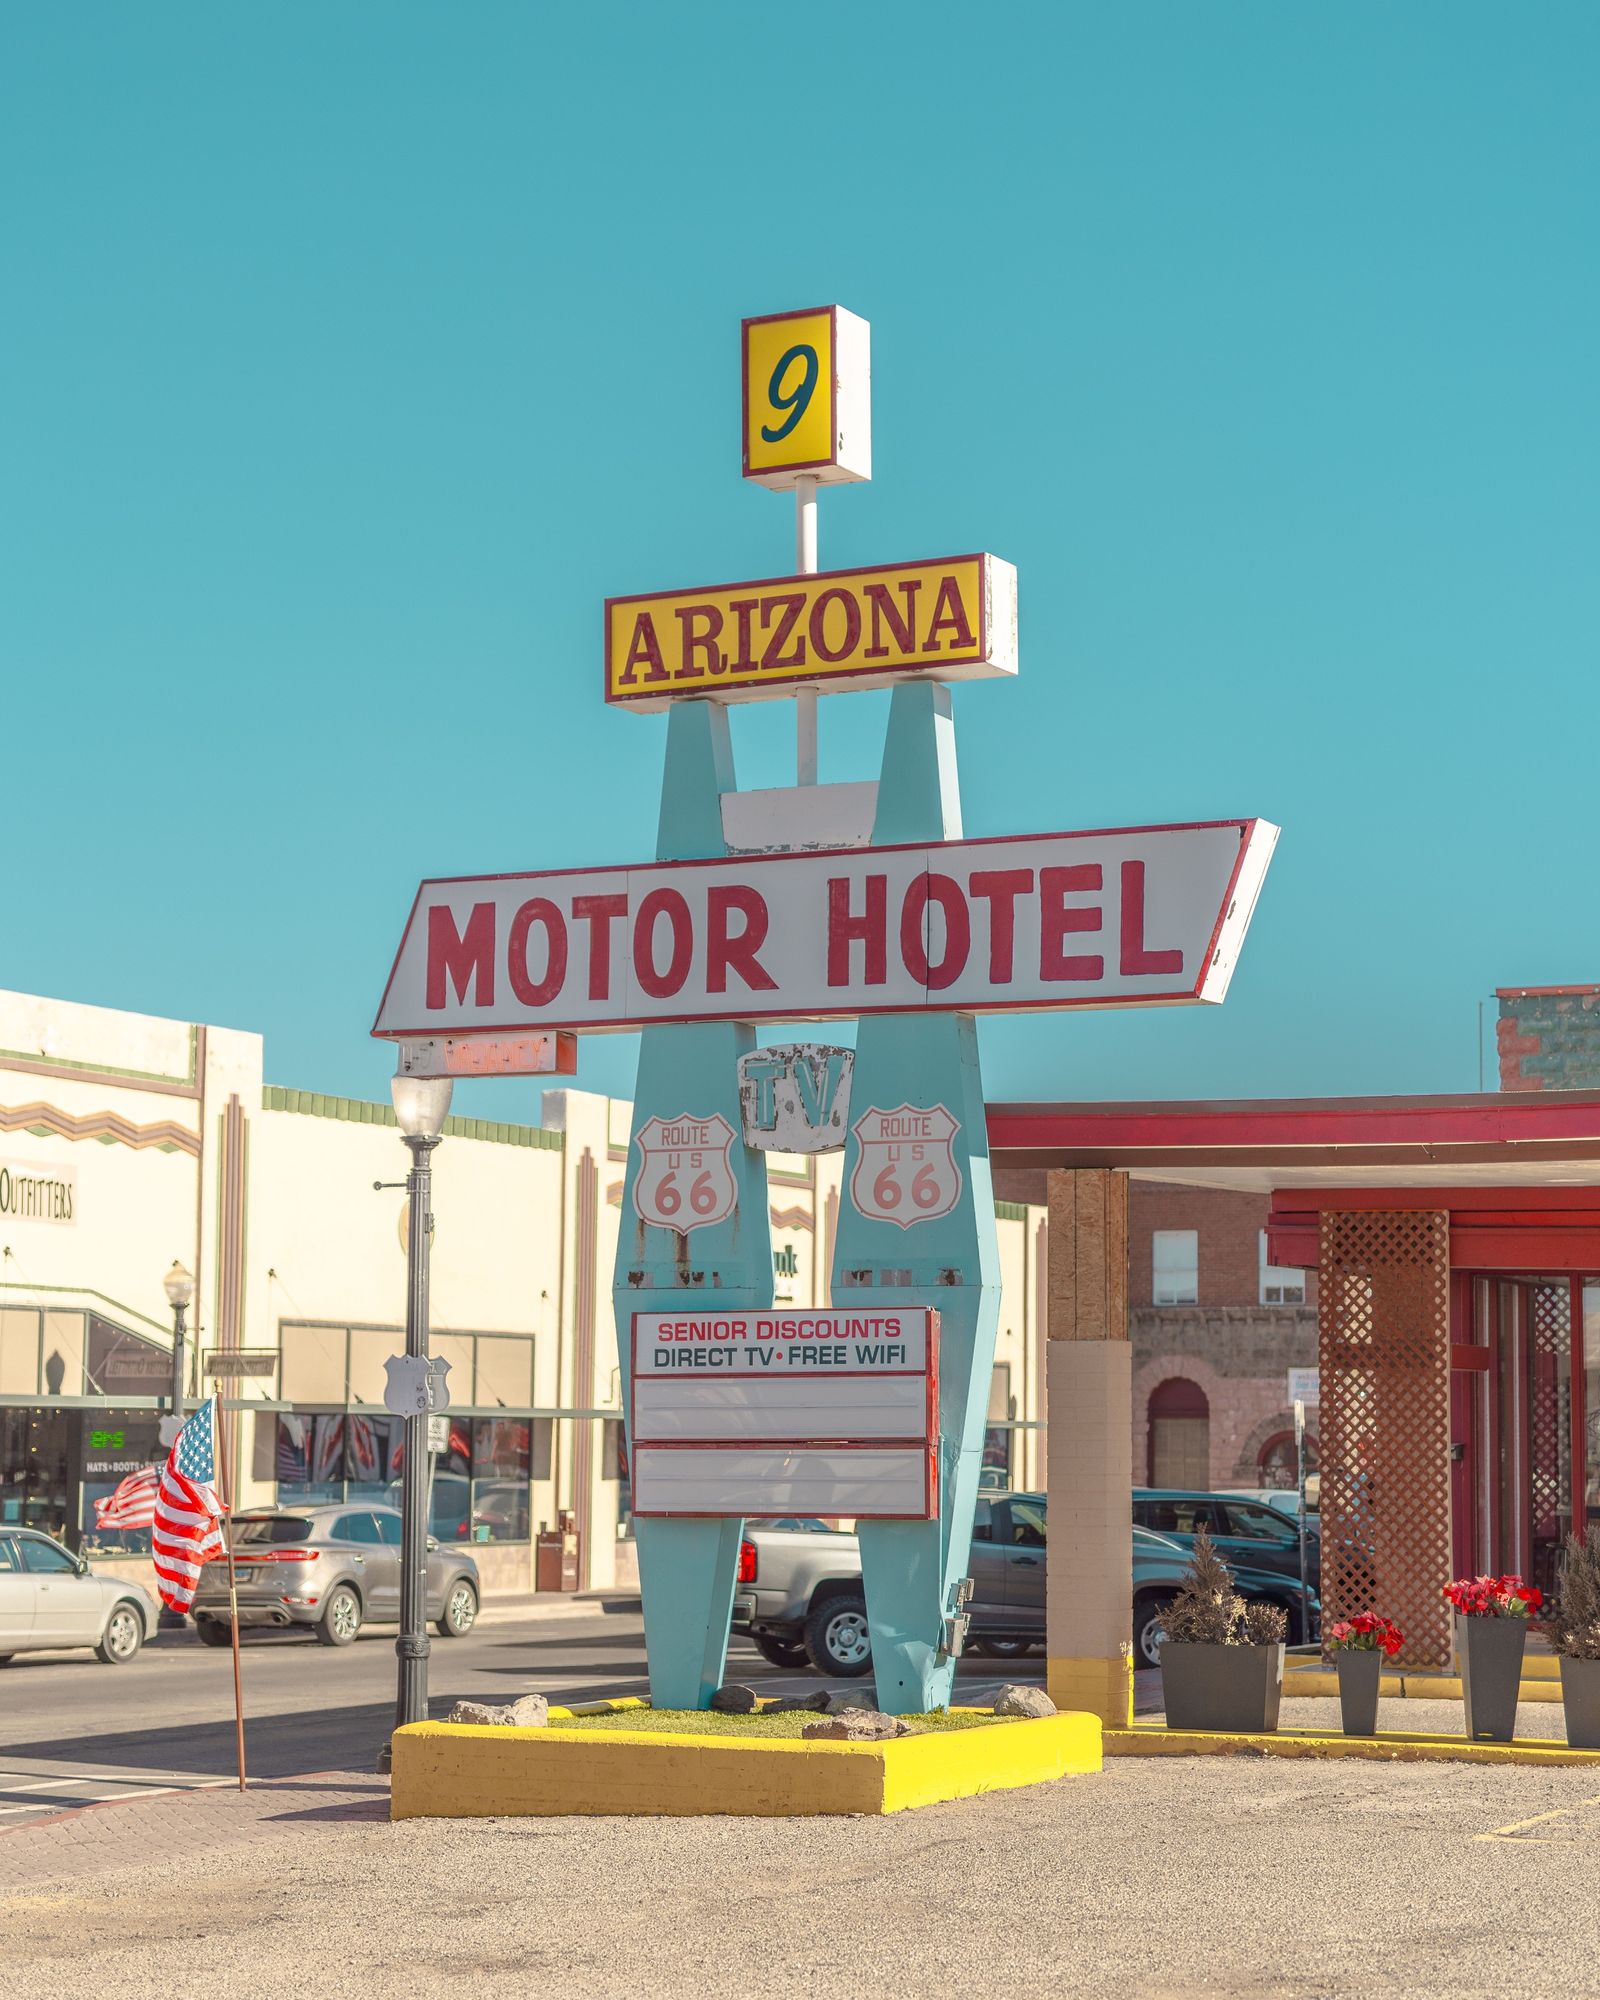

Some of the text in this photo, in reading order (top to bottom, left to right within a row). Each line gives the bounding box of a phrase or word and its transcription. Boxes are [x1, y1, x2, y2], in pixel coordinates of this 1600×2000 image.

[761, 344, 819, 443] 9
[618, 575, 977, 685] ARIZONA
[425, 860, 1183, 1009] MOTOR HOTEL
[744, 1055, 845, 1130] TV
[661, 1125, 710, 1147] ROUTE
[880, 1116, 932, 1138] ROUTE
[655, 1170, 717, 1216] 66
[873, 1163, 940, 1210] 66
[658, 1318, 901, 1342] SENIOR DISCOUNTS
[654, 1344, 906, 1367] DIRECT TV FREE WIFI
[86, 1461, 109, 1473] HATS
[112, 1461, 140, 1473] BOOTS
